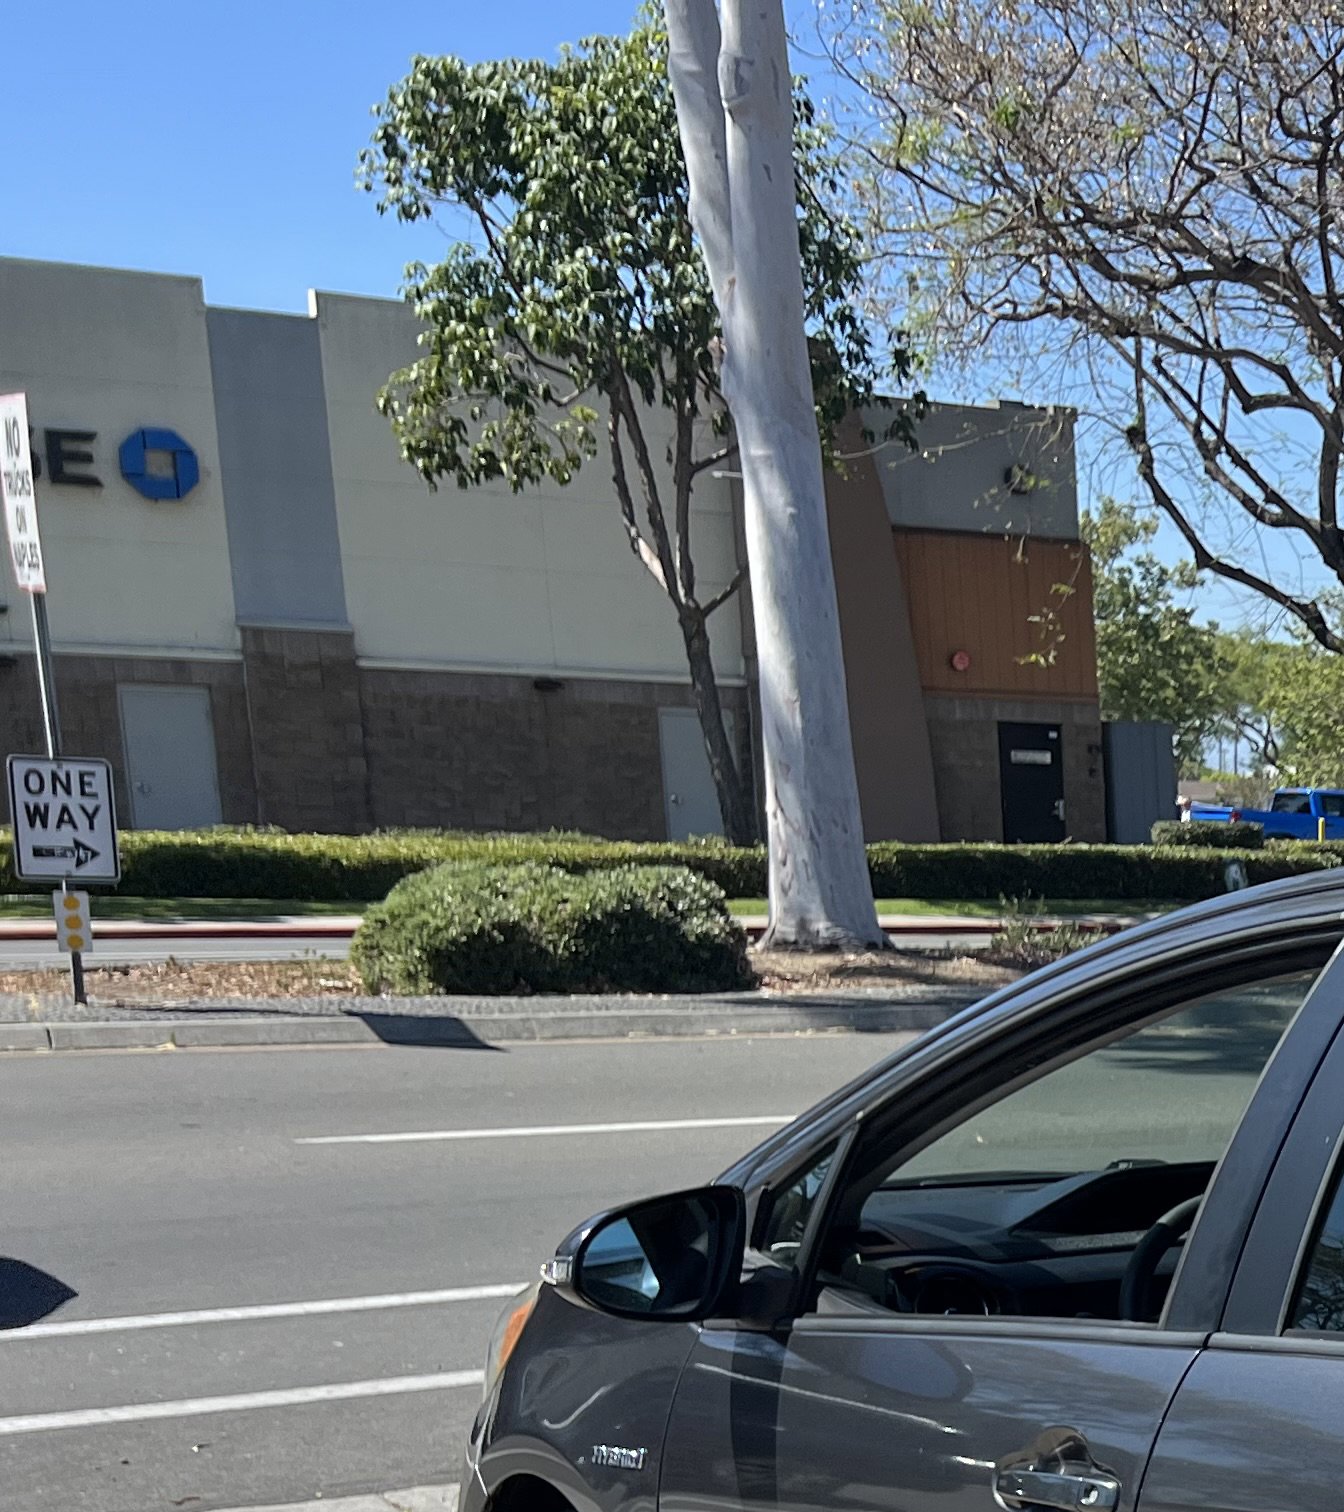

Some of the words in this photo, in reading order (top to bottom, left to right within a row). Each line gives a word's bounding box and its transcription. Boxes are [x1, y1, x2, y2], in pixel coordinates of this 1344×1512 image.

[4, 416, 20, 457] NO
[24, 768, 98, 798] ONE
[24, 802, 100, 831] WAY
